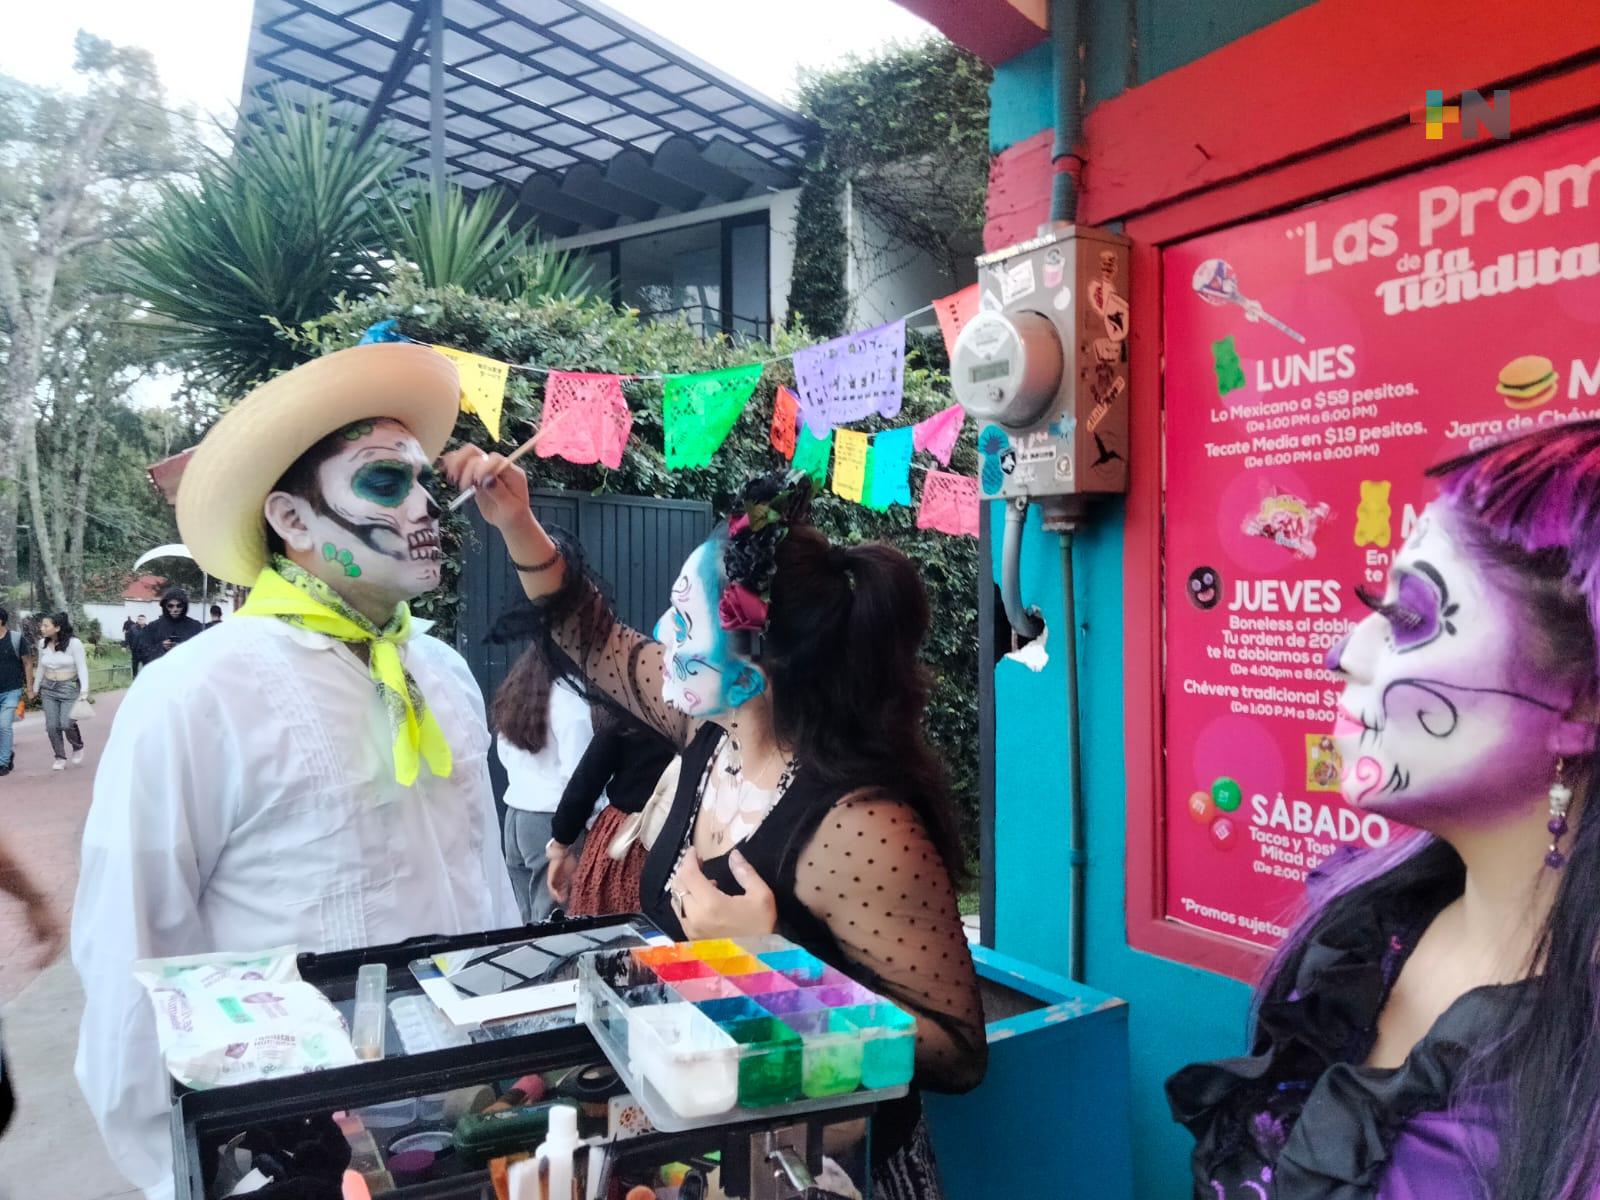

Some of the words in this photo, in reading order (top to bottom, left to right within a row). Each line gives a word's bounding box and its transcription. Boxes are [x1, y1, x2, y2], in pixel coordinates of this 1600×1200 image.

[1396, 253, 1421, 273] de
[1256, 344, 1356, 392] LUNES
[1211, 409, 1228, 423] Lo
[1230, 398, 1298, 421] Mexicano
[1301, 399, 1312, 410] a
[1352, 382, 1419, 405] pesitos.
[1291, 412, 1311, 427] PM
[1311, 414, 1320, 425] a
[1352, 404, 1378, 420] PM)
[1444, 420, 1503, 439] Jarra
[1506, 413, 1534, 432] de
[1204, 440, 1250, 458] Tecate
[1253, 434, 1299, 452] Media
[1302, 432, 1322, 446] en
[1325, 426, 1357, 446] $19
[1360, 421, 1428, 442] pesitos.
[1293, 450, 1312, 464] PM
[1312, 452, 1323, 462] a
[1354, 443, 1380, 459] PM)
[1366, 549, 1388, 566] En
[1365, 568, 1383, 582] te
[1228, 579, 1341, 613] JUEVES
[1229, 615, 1294, 632] Boneless
[1296, 617, 1311, 632] al
[1222, 629, 1239, 645] Tu
[1240, 631, 1284, 647] orden
[1285, 633, 1306, 648] de
[1207, 645, 1221, 658] te
[1222, 645, 1236, 660] la
[1238, 646, 1310, 664] doblamos
[1183, 678, 1240, 697] Chévere
[1241, 684, 1320, 705] tradicional
[1250, 792, 1390, 849] SÁBADO
[1248, 826, 1290, 847] Tacos
[1292, 837, 1303, 852] y
[1261, 844, 1304, 867] Mitad
[1238, 915, 1290, 940] sujetas
